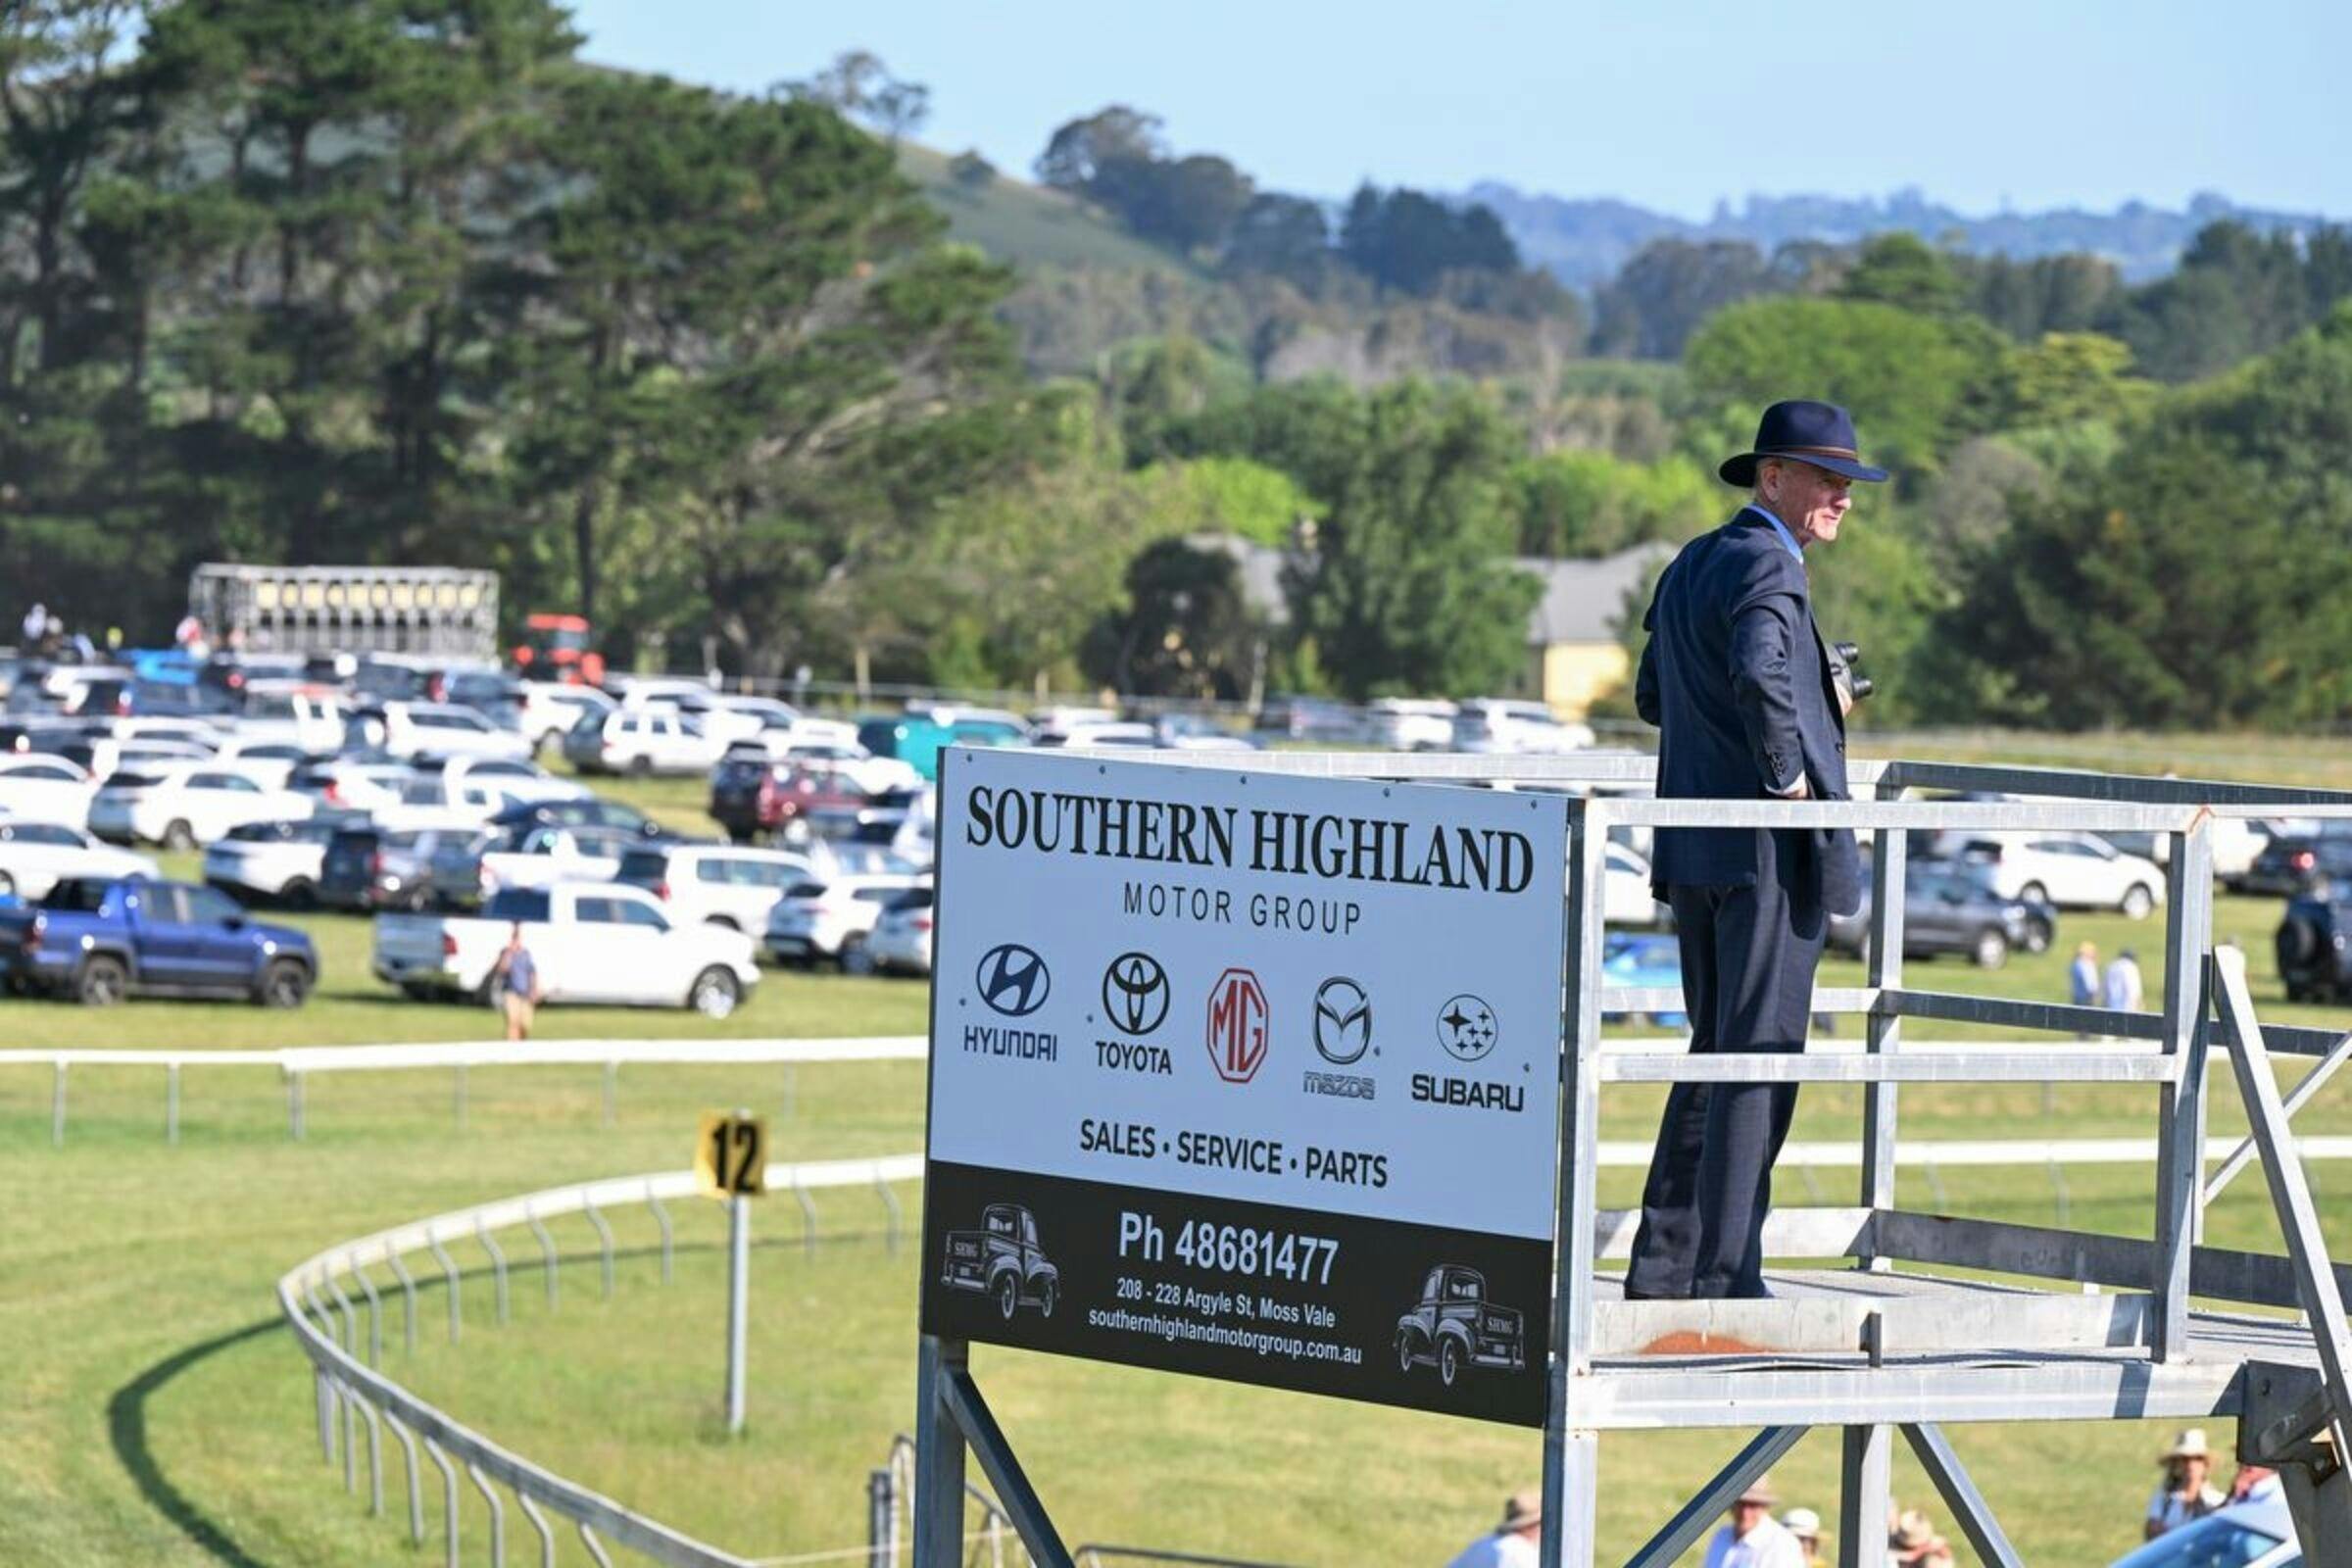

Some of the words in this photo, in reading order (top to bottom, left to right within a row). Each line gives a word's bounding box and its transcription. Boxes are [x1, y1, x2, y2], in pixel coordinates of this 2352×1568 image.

[966, 785, 1238, 867] SOUTHERN
[1249, 808, 1534, 894] HIGHLAND
[1123, 881, 1231, 923] MOTOR
[1250, 893, 1360, 935] GROUP
[963, 1025, 1057, 1062] HYUNDAI
[1212, 979, 1263, 1072] MG
[1095, 1040, 1173, 1075] TOYOTA
[1411, 1072, 1525, 1112] SUBARU
[711, 1119, 759, 1195] 12
[1080, 1118, 1156, 1158] SALES
[1177, 1130, 1283, 1175] SERVICE
[1305, 1147, 1389, 1188] PARTS
[1119, 1211, 1164, 1262] Ph
[1176, 1220, 1339, 1285] 48681477
[1116, 1277, 1143, 1300] 208
[1154, 1283, 1181, 1304] 228
[1185, 1287, 1232, 1316] Argyle
[1236, 1293, 1255, 1320] St,
[1260, 1298, 1299, 1323] Moss
[1304, 1303, 1336, 1328] Vale
[1089, 1307, 1362, 1365] southernhighlandmotorgroup.com.au
